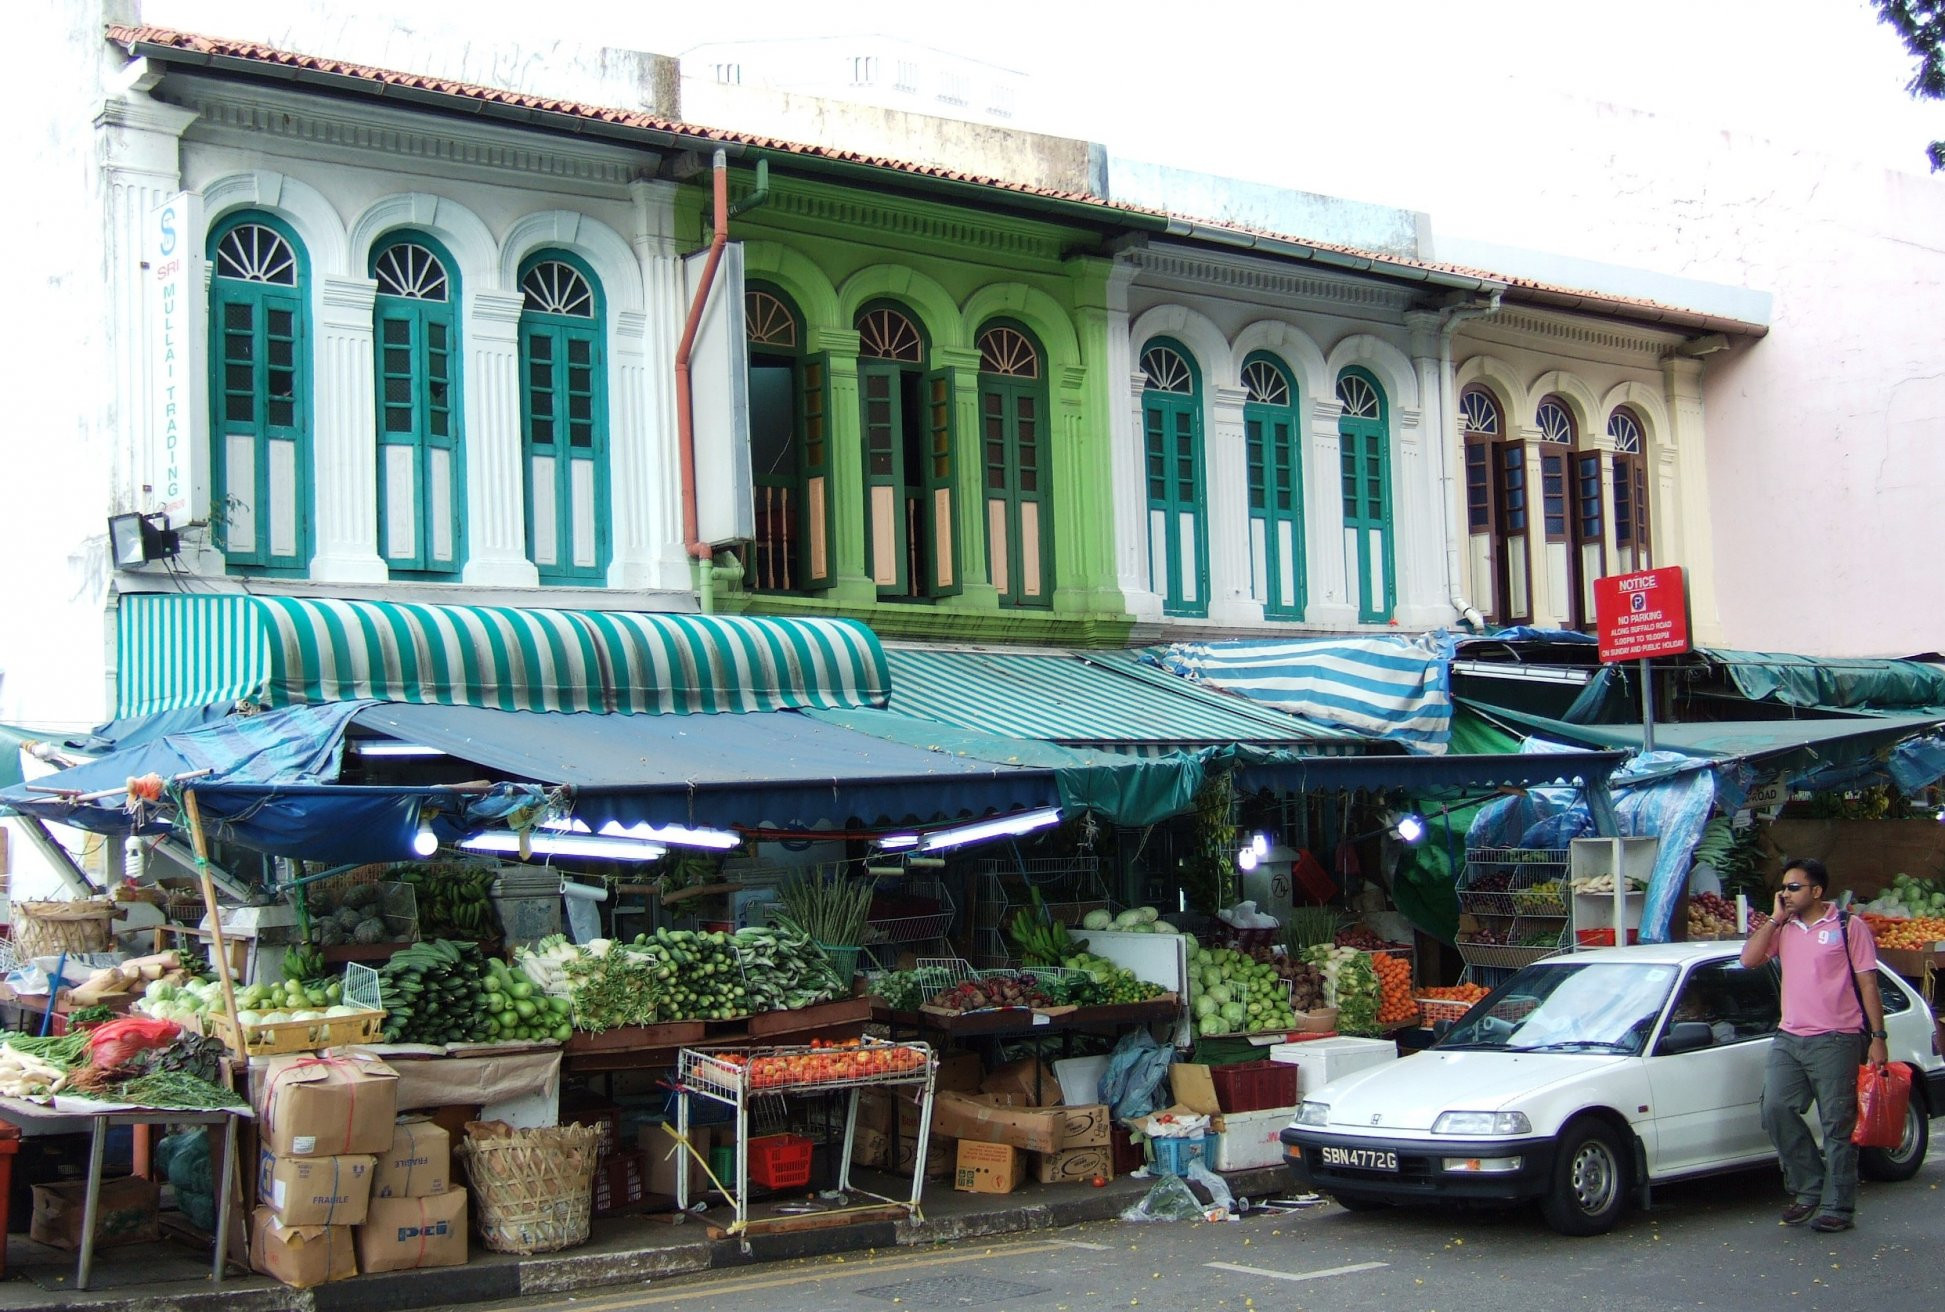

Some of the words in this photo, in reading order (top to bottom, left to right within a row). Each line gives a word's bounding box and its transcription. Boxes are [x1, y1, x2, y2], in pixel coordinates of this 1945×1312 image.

[157, 258, 180, 281] SRI
[163, 282, 176, 378] MULLAI
[166, 386, 179, 498] TRADING
[1619, 575, 1655, 591] NOTICE
[1618, 615, 1629, 626] NO
[1630, 610, 1662, 623] PARKING
[1611, 627, 1629, 636] ALONG
[1630, 624, 1655, 634] BUFFALO
[1656, 621, 1672, 629] ROAD
[1601, 649, 1610, 658] ON
[1610, 646, 1630, 656] SUNDAY
[1630, 644, 1642, 653] AND
[1641, 642, 1661, 652] PUBLIC
[1662, 640, 1684, 649] HOLIDAY
[1322, 1147, 1397, 1169] SBN4772G
